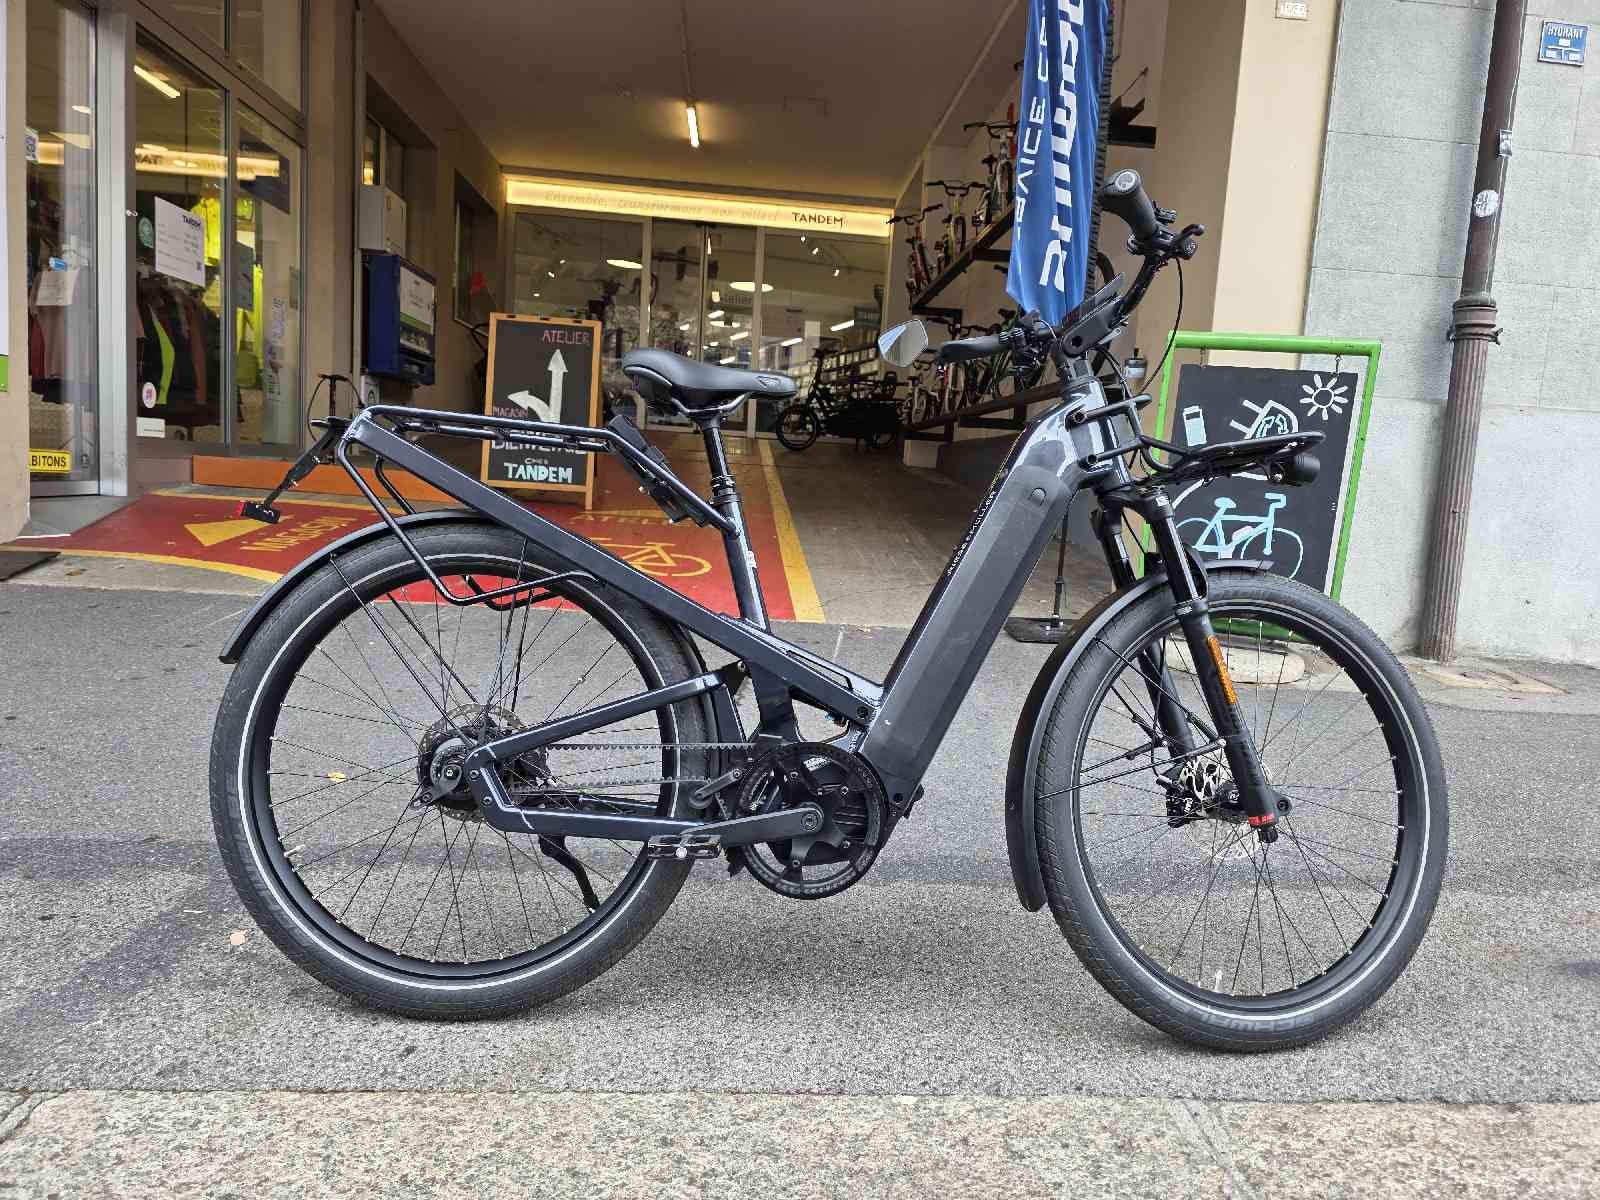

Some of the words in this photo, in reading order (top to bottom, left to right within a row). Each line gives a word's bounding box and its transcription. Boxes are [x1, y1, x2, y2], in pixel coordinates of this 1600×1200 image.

[1546, 23, 1585, 39] HYDRANT
[791, 211, 844, 228] TANDEM
[542, 329, 591, 347] ATELIER
[492, 406, 529, 419] MAGASIN
[503, 462, 573, 483] TANDEM
